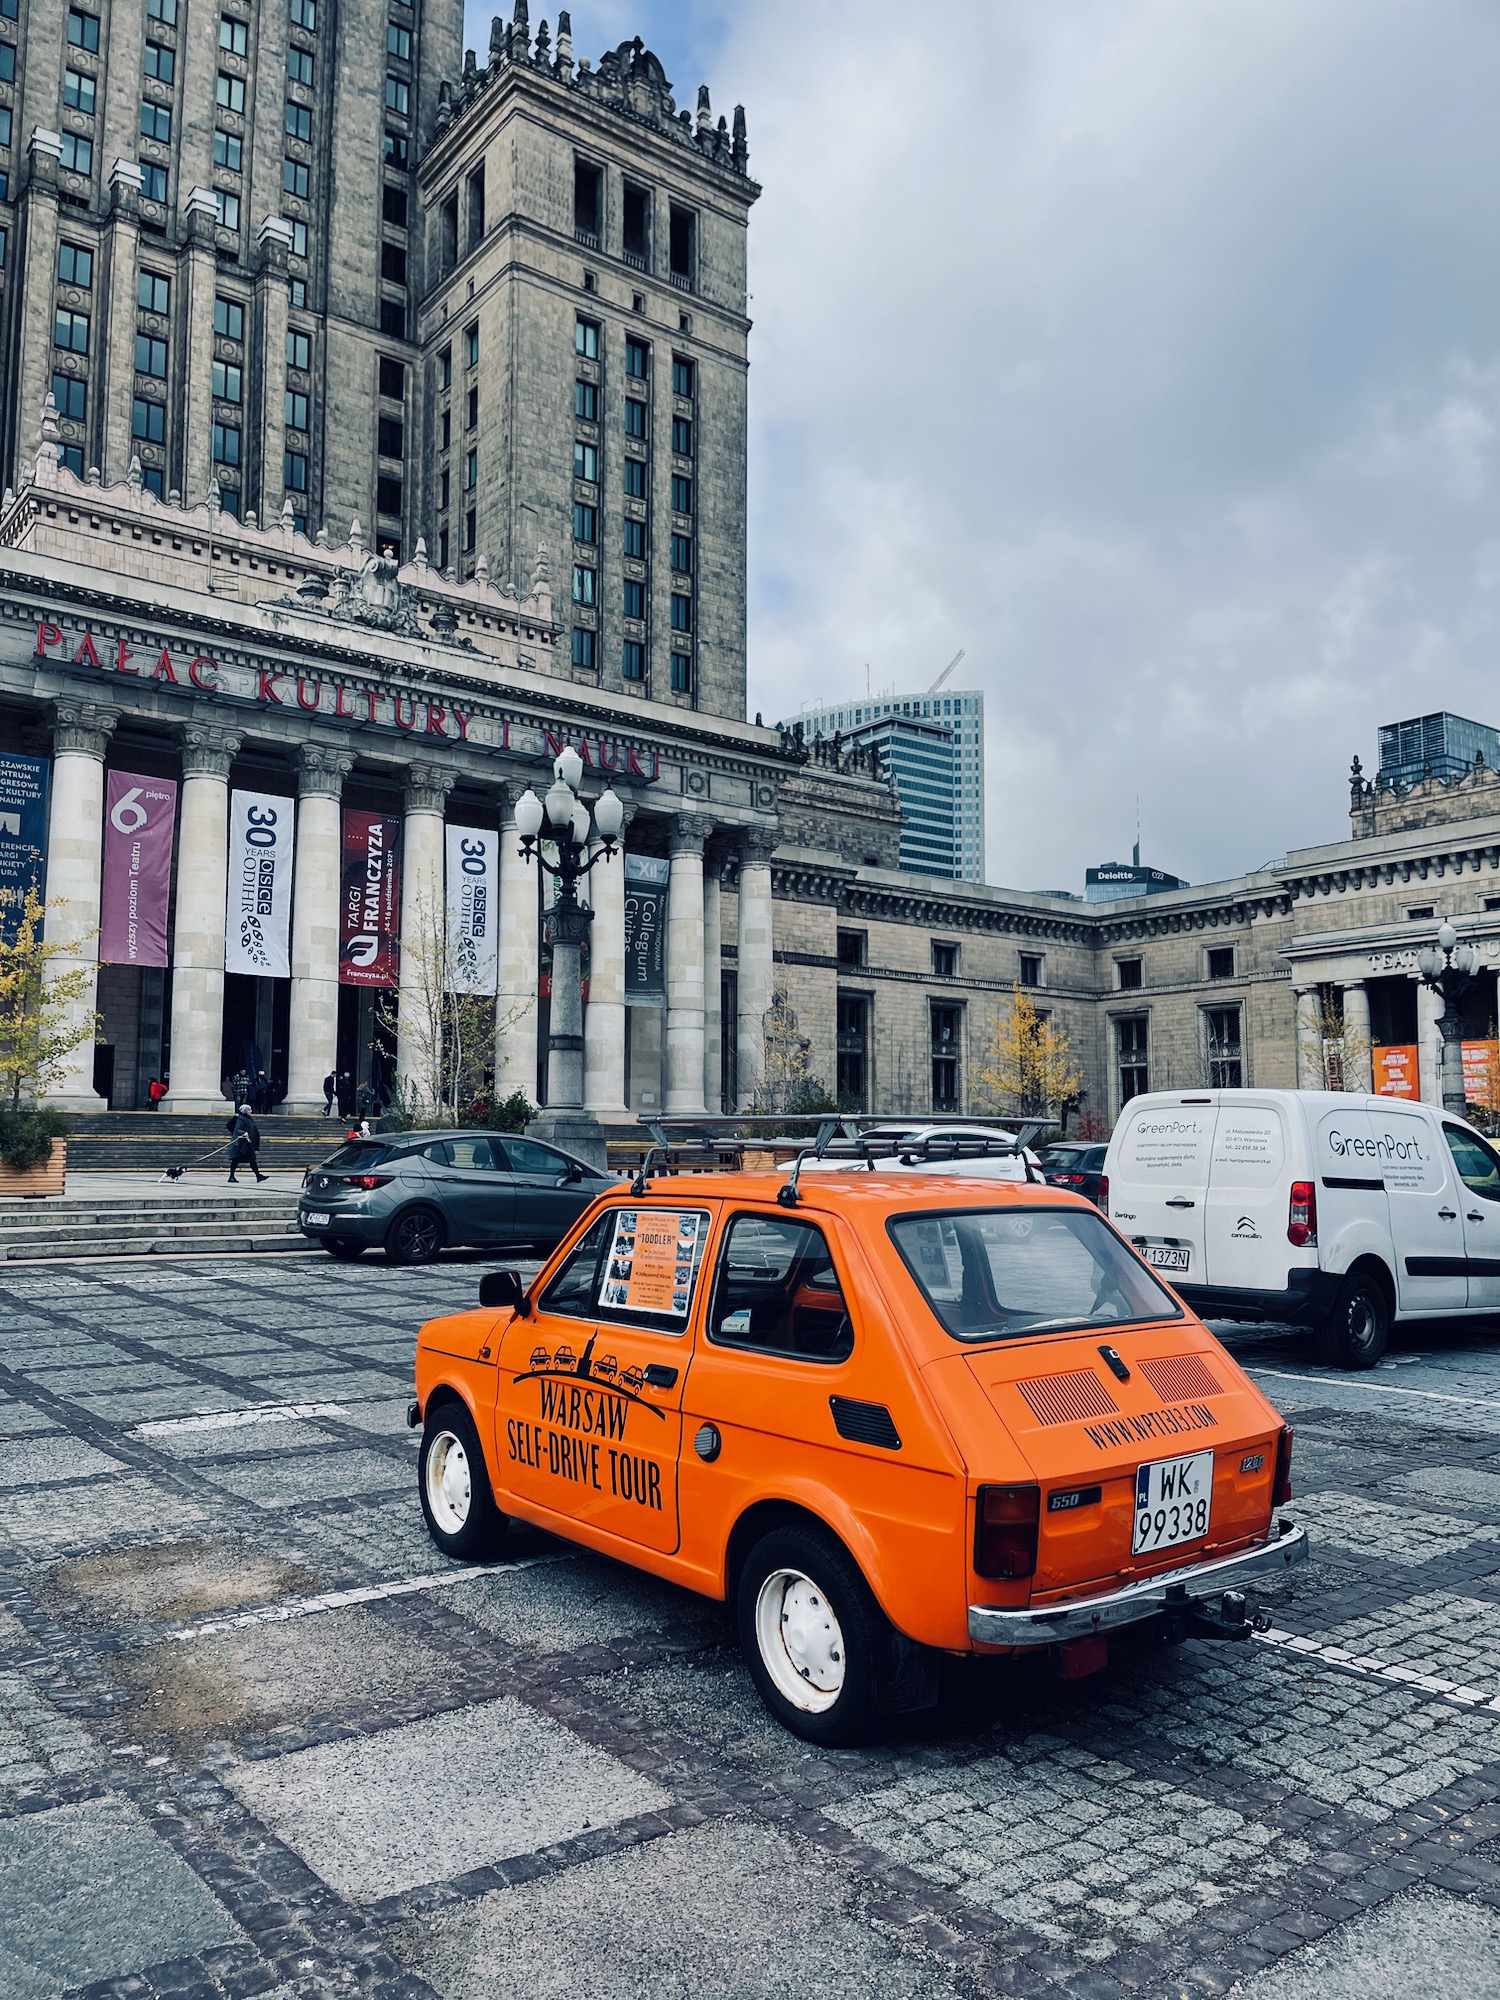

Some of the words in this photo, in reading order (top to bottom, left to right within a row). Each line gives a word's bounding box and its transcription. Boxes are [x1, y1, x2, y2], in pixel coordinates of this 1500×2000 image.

[35, 622, 219, 691] PAŁAC
[258, 669, 474, 740] KULTURY
[502, 719, 511, 749] I
[544, 729, 660, 780] NAUKI
[5, 788, 42, 800] KULTURY
[110, 787, 148, 835] 6
[146, 790, 171, 801] piętro
[246, 805, 278, 848] 30
[128, 841, 141, 877] Teatru
[244, 847, 276, 858] YEARS
[460, 838, 487, 876] 30
[241, 857, 257, 913] ODIHR
[257, 859, 275, 915] osce
[363, 824, 383, 931] FRANCZYZA
[461, 875, 487, 885] YEARS
[1097, 871, 1133, 880] Deloitte
[128, 879, 139, 920] poziom
[347, 885, 362, 929] TARGI
[460, 884, 473, 935] ODIHR
[472, 886, 487, 937] osce
[126, 920, 139, 959] wyższy
[625, 898, 639, 953] Civitas
[635, 900, 657, 982] Collegium
[346, 969, 389, 980] Franczyza.pl
[1367, 949, 1421, 971] TEAT
[1137, 1121, 1197, 1134] GreenPort
[1328, 1130, 1423, 1161] GreenPort
[1114, 1211, 1137, 1220] Berlingo
[1152, 1249, 1186, 1266] 1373N
[540, 1378, 629, 1442] WARSAW
[1083, 1403, 1219, 1450] WWW.WPT1313.COM
[507, 1418, 602, 1491] SELF-DRIVE
[608, 1448, 663, 1512] TOUR
[1160, 1460, 1194, 1502] WK
[1051, 1493, 1080, 1509] 650
[1138, 1492, 1148, 1503] PL
[1138, 1498, 1207, 1549] 99338
